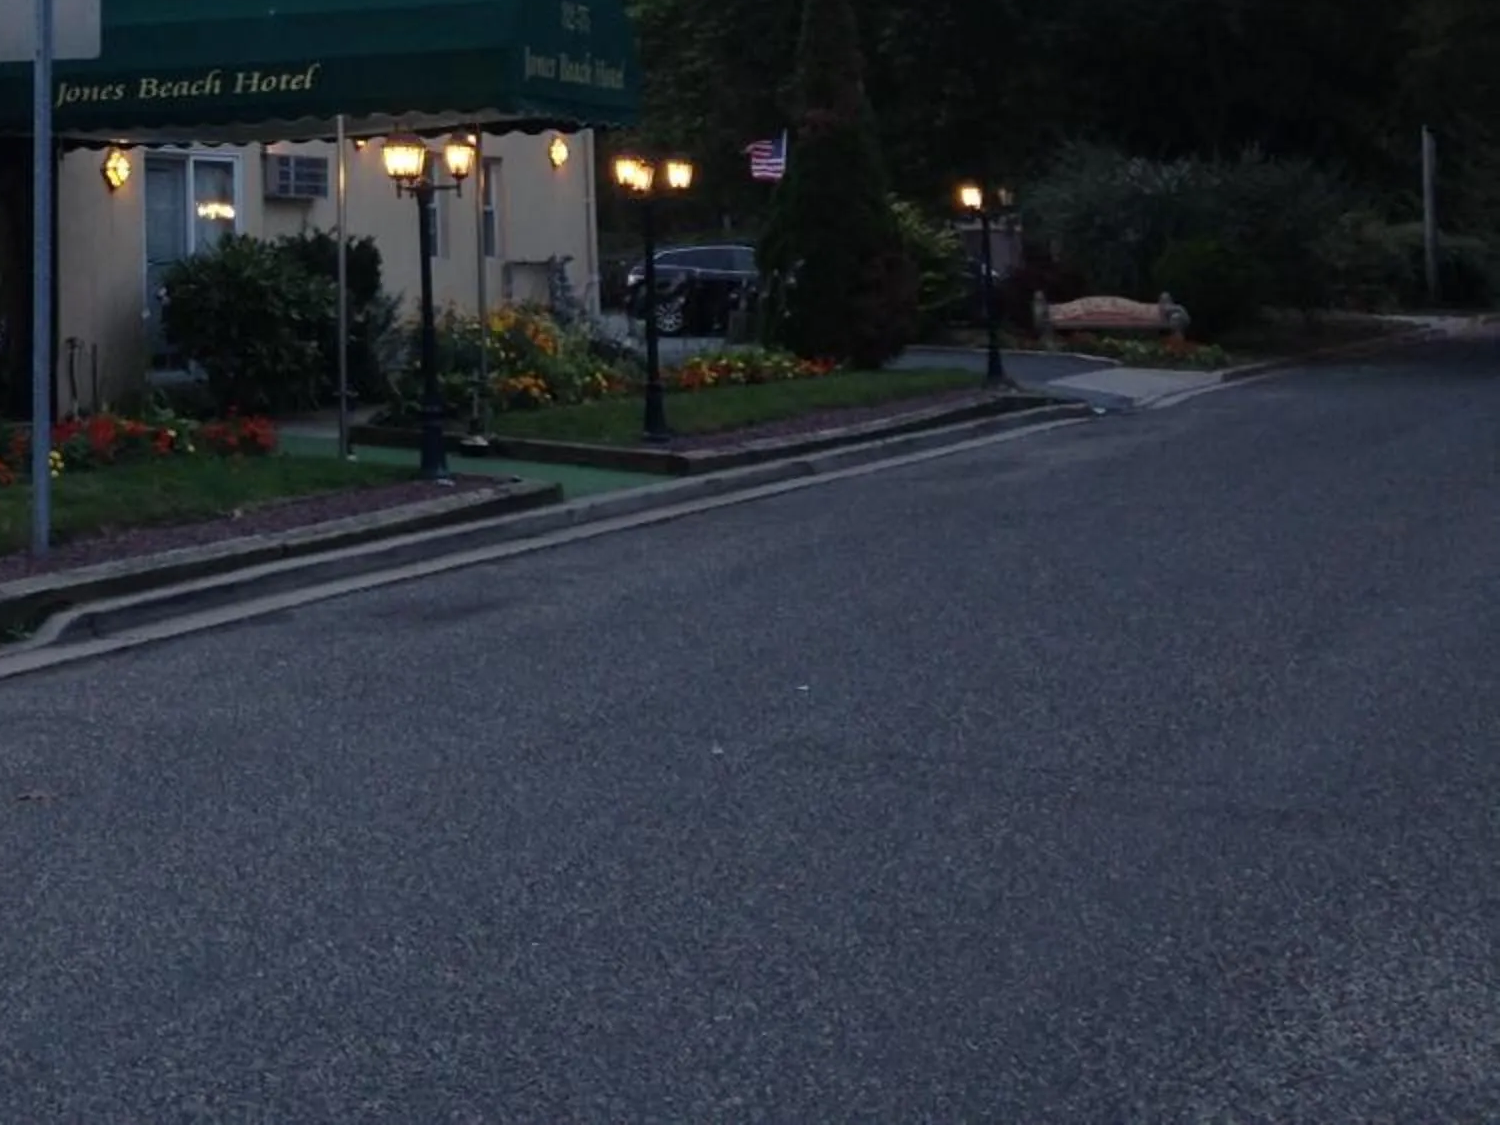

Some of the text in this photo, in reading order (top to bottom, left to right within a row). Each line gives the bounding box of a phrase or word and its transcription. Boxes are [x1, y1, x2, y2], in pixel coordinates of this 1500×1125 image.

[56, 63, 320, 107] Jones Beach Hotel
